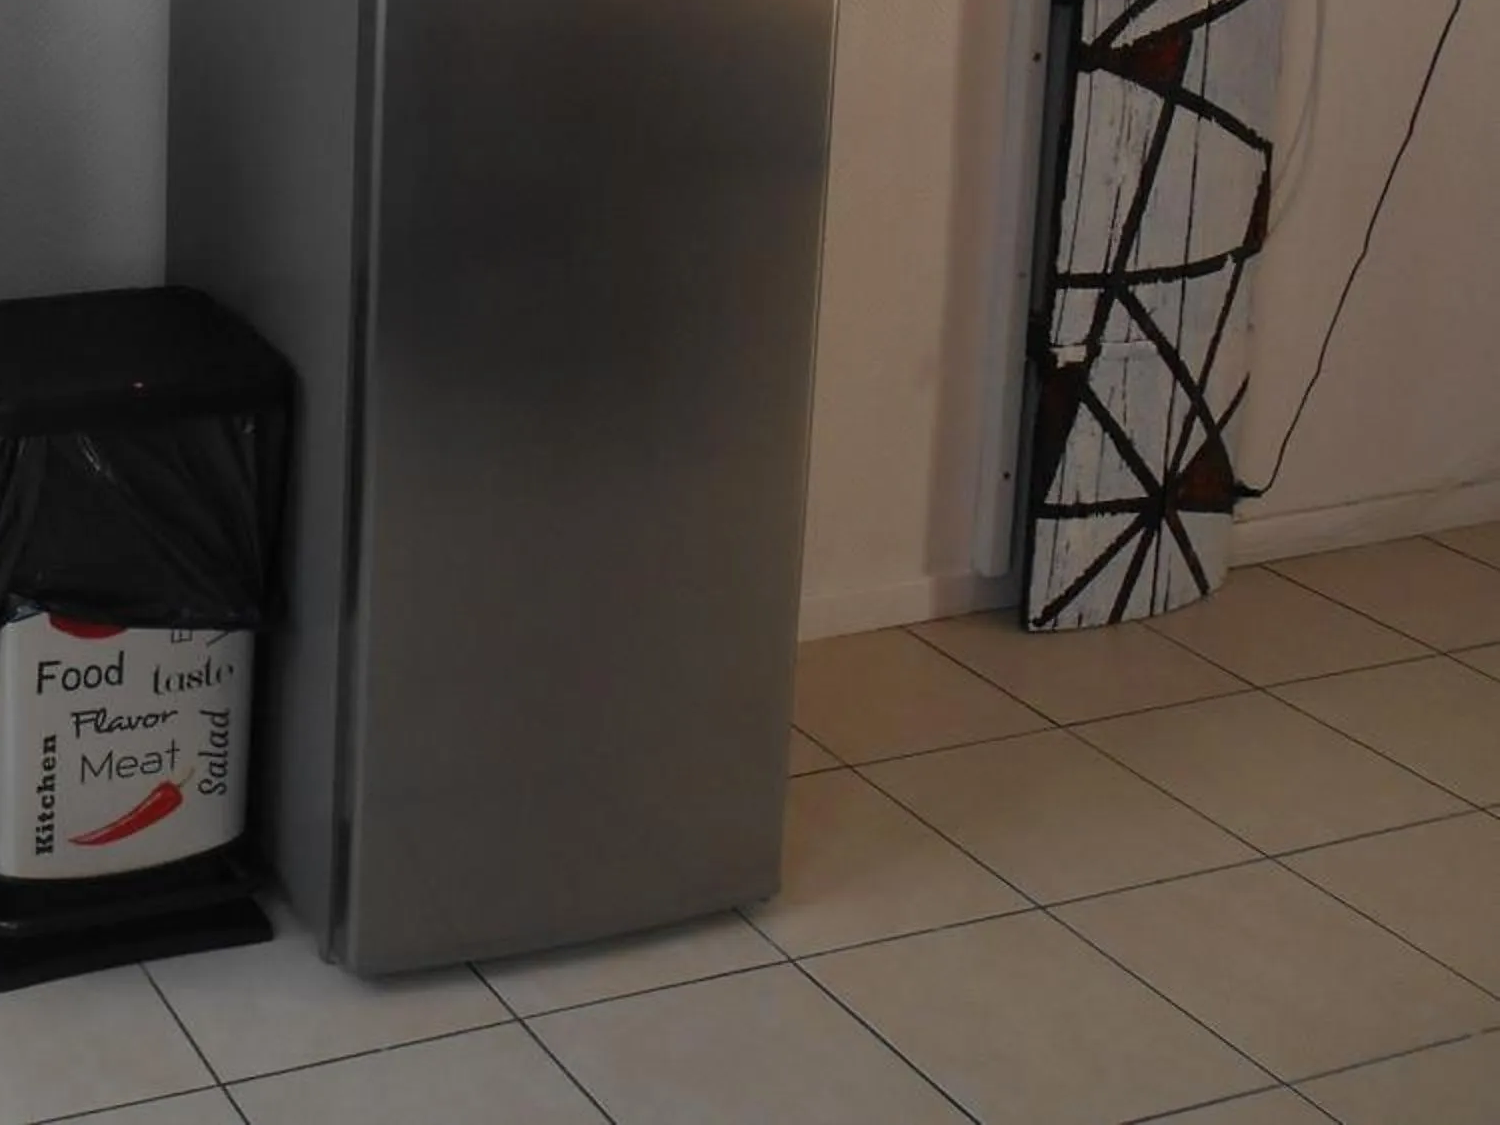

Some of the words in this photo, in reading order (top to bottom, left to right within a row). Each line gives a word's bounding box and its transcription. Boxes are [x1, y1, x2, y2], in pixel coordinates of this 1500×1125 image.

[35, 650, 125, 695] Food
[153, 655, 235, 696] taste
[70, 708, 179, 739] Flavor
[79, 738, 181, 785] Meat
[198, 708, 231, 796] Salad
[35, 734, 57, 856] Kitchen
